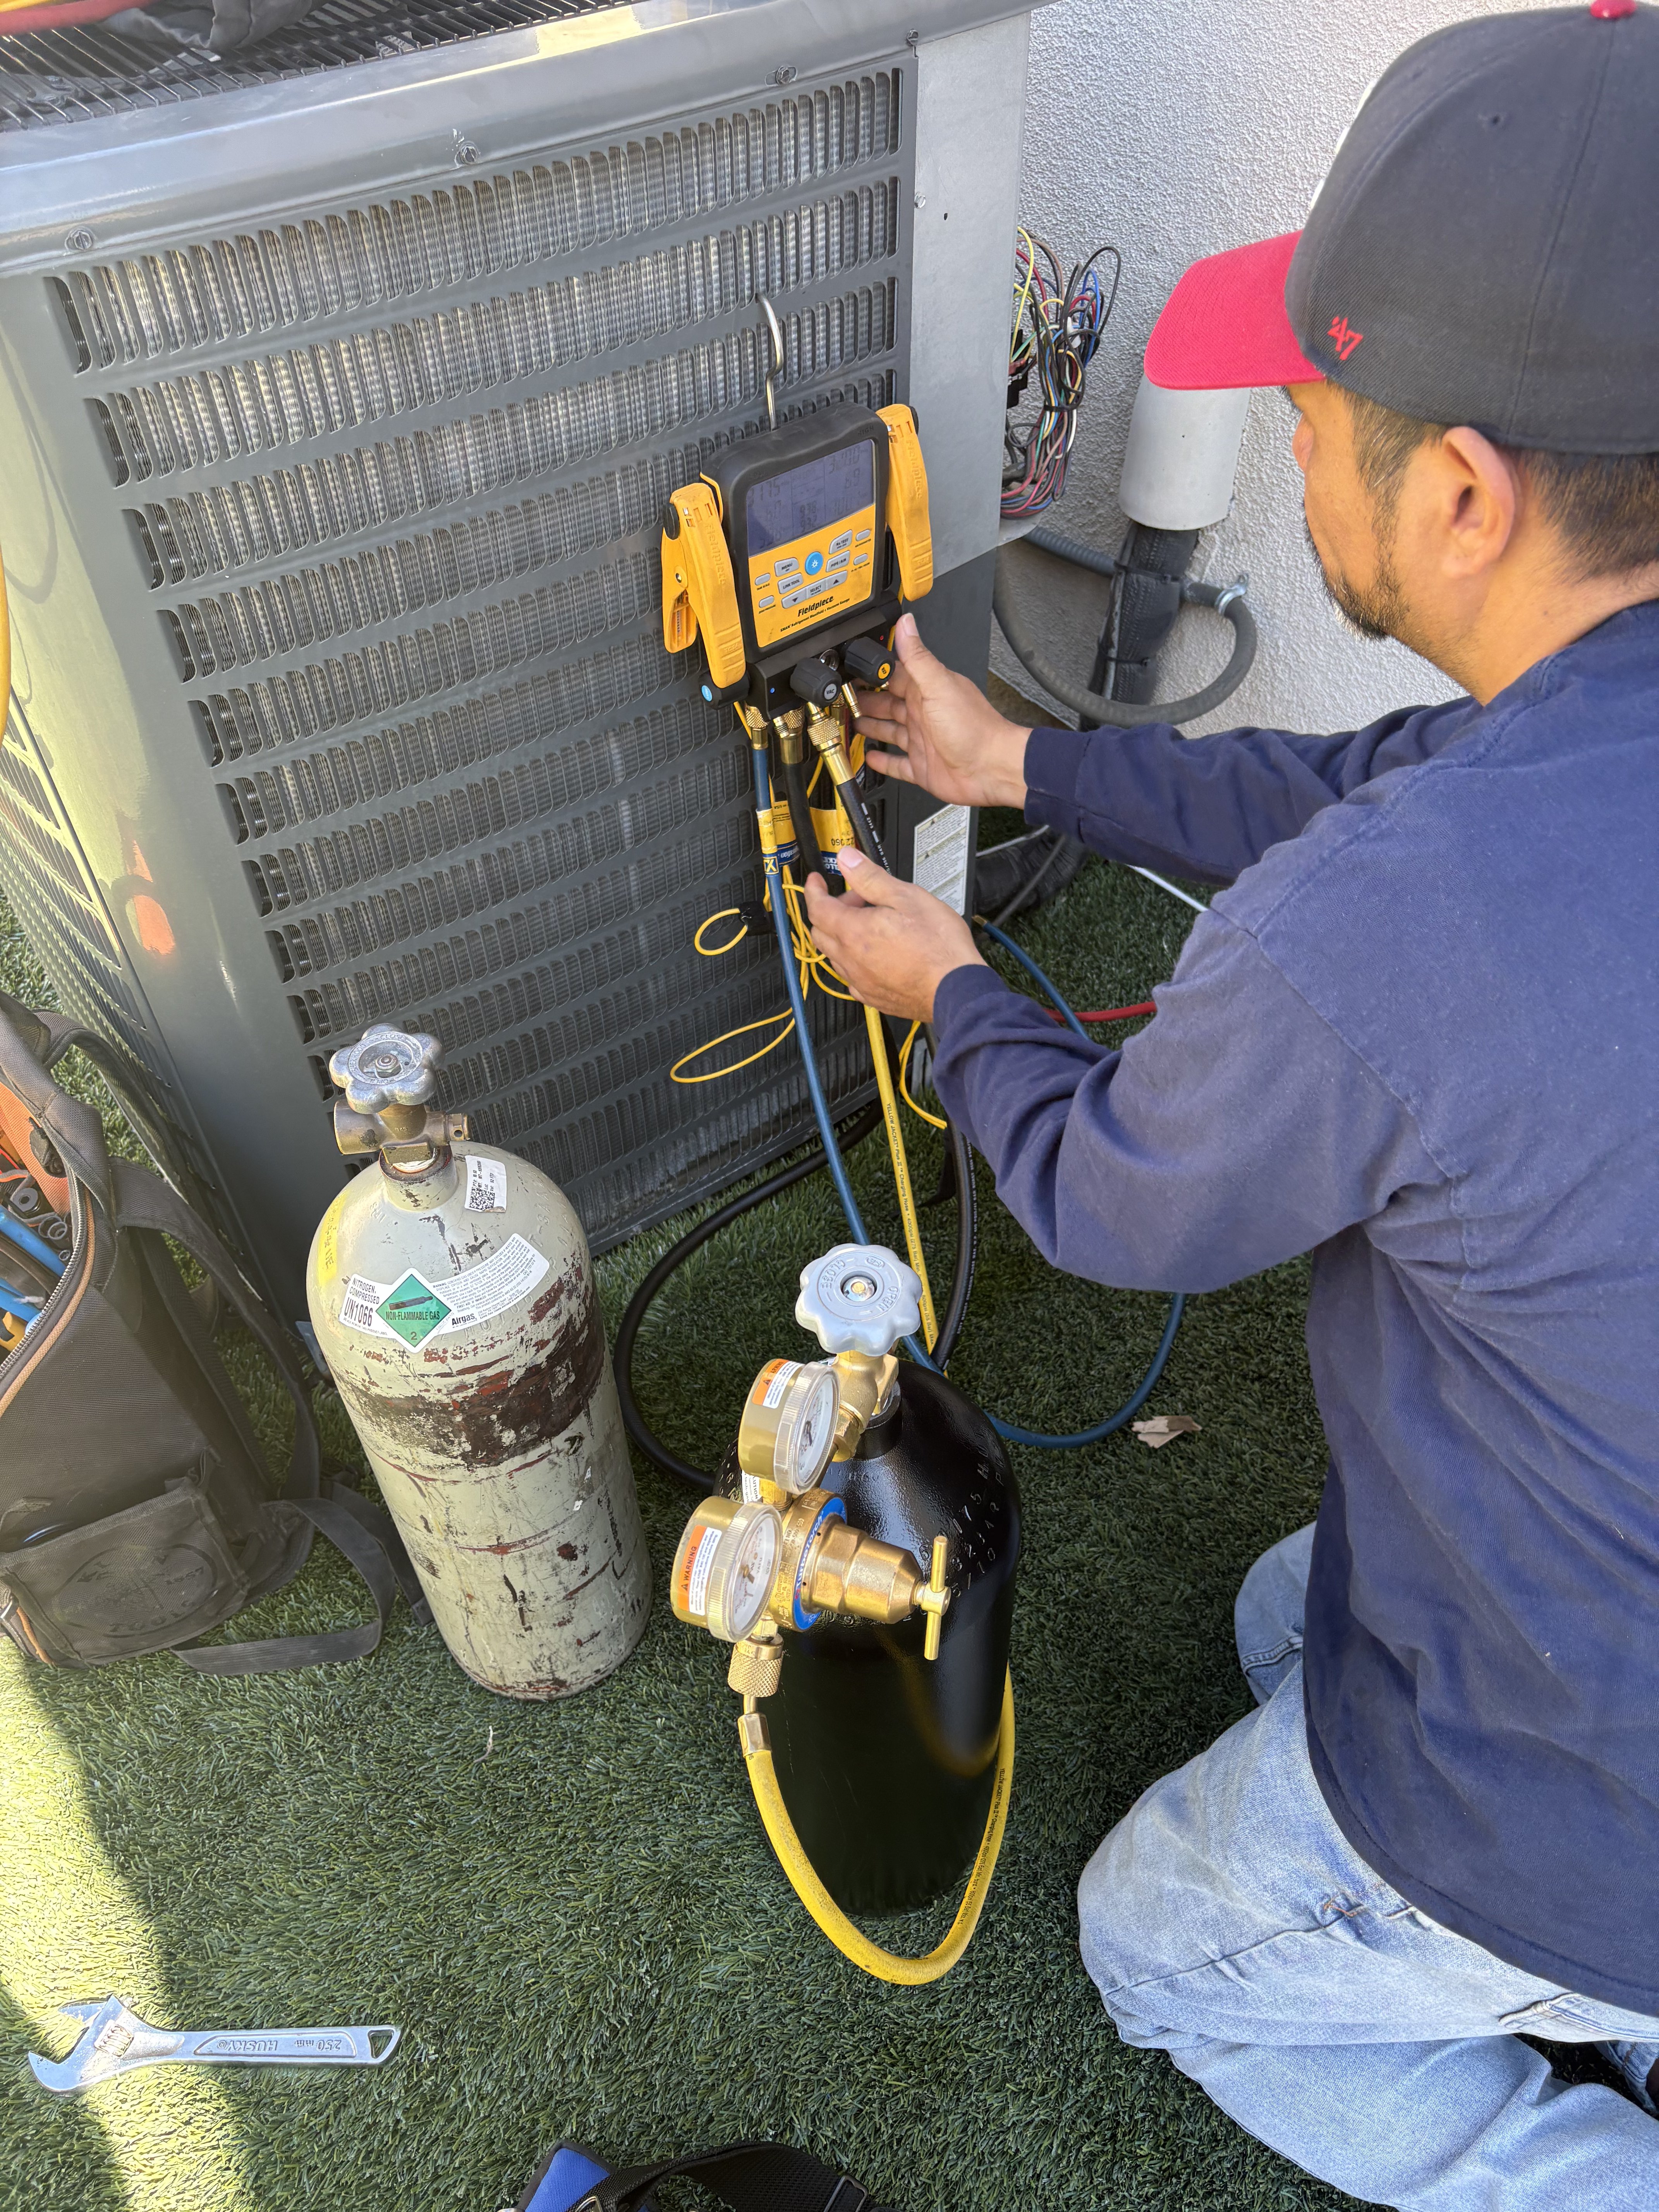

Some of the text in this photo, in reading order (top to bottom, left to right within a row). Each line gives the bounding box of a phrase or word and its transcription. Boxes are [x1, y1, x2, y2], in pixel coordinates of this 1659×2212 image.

[798, 596, 834, 617] Fieldpiece
[886, 1103, 895, 1125] YELLOW
[821, 1259, 846, 1290] CLOSE
[352, 1277, 376, 1294] NITROGEN,
[349, 1286, 380, 1305] COMPRESSED
[876, 1286, 899, 1312] OPEN
[344, 1297, 373, 1327] UN1066
[386, 1311, 440, 1321] NON-FLAMMABLE GAS
[451, 1313, 476, 1326] Airgas
[410, 1331, 418, 1340] 2
[684, 1546, 697, 1582] WARNING
[998, 1768, 1006, 1784] YELLOW
[988, 1818, 997, 1834] Charging
[294, 2040, 314, 2048] mm
[316, 2039, 342, 2051] 250
